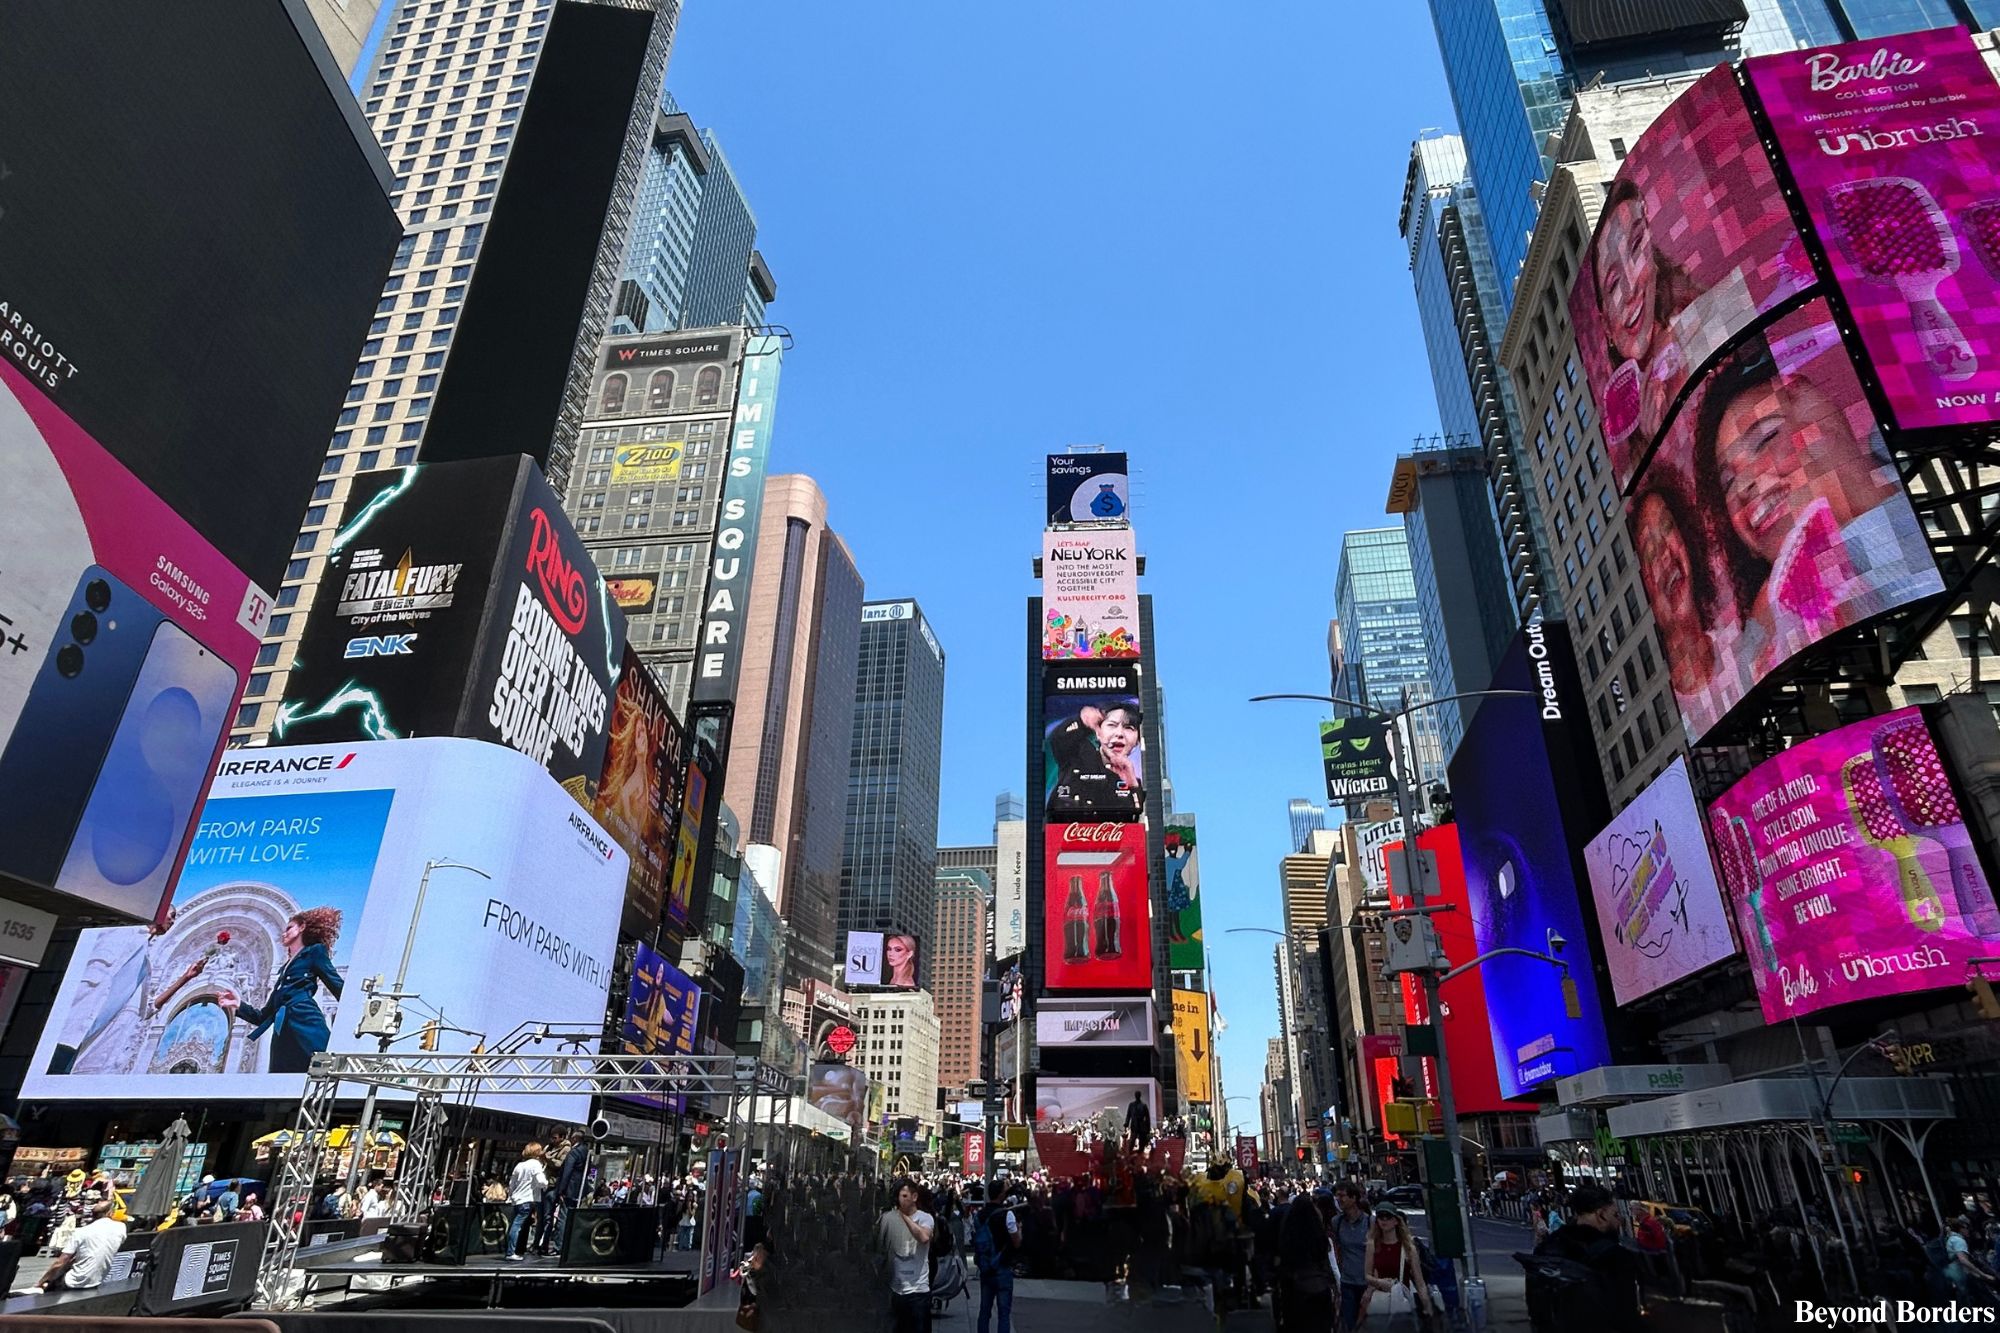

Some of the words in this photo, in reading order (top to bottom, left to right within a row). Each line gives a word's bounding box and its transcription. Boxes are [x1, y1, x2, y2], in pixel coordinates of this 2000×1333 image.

[1805, 48, 1926, 91] Barbie
[1835, 82, 1919, 100] COLLECTION
[1863, 101, 1910, 113] inspired
[1911, 99, 1926, 107] by
[0, 301, 79, 378] ARRIOTT
[640, 348, 671, 357] TIMES
[675, 344, 720, 355] SQUARE
[0, 329, 59, 387] RQUIS
[730, 355, 761, 478] TIMES
[1936, 393, 1986, 409] NOW
[1051, 456, 1075, 466] Your
[1051, 465, 1092, 475] savings
[156, 555, 210, 605] SAMSUNG
[340, 569, 400, 601] FATAL
[401, 563, 463, 596] FURY
[526, 507, 588, 634] RING
[1056, 570, 1124, 578] NEURODIVERGENT
[150, 572, 187, 609] Galaxy
[702, 498, 746, 678] SQUARE
[350, 616, 370, 625] City
[370, 614, 381, 623] of
[382, 613, 398, 622] the
[343, 633, 418, 658] SNK
[511, 581, 573, 687] BOXING
[569, 654, 607, 735] TAKES
[501, 628, 550, 715] OVER
[545, 677, 588, 758] TIMES
[1057, 676, 1127, 689] SAMSUNG
[1537, 660, 1561, 719] Dream
[489, 674, 557, 773] SQUARE
[627, 666, 682, 772] SHAKIRA
[215, 755, 335, 777] IRFRANCE
[231, 779, 272, 788] ELEGANCE
[292, 777, 328, 786] JOURNEY
[1752, 799, 1768, 822] ONE
[1765, 791, 1778, 813] OF
[1778, 788, 1788, 806] A
[1785, 774, 1821, 801] KIND.
[196, 820, 256, 840] FROM
[260, 817, 323, 837] PARIS
[568, 812, 608, 857] AIRFRANCE
[1063, 822, 1125, 842] Coca-Cola
[1363, 820, 1402, 846] LITTLE
[1763, 816, 1790, 845] STYLE
[1787, 804, 1821, 832] ICON.
[189, 846, 245, 865] WITH
[250, 843, 310, 862] LOVE.
[1760, 853, 1780, 878] OWN
[1775, 841, 1802, 868] YOUR
[1800, 823, 1855, 857] UNIQUE.
[1013, 877, 1021, 900] Linda
[1775, 872, 1801, 901] SHINE
[1799, 857, 1847, 890] BRIGHT.
[1793, 900, 1810, 925] BE
[1807, 893, 1837, 919] YOU.
[2, 919, 36, 941] 1535
[483, 898, 534, 949] FROM
[534, 926, 571, 968] PARIS
[571, 946, 599, 984] WITH
[1778, 964, 1819, 1007] Barbie
[1187, 1001, 1199, 1014] in
[969, 1134, 983, 1162] tkts
[1241, 1137, 1255, 1167] tkts
[213, 1252, 232, 1263] TIMES
